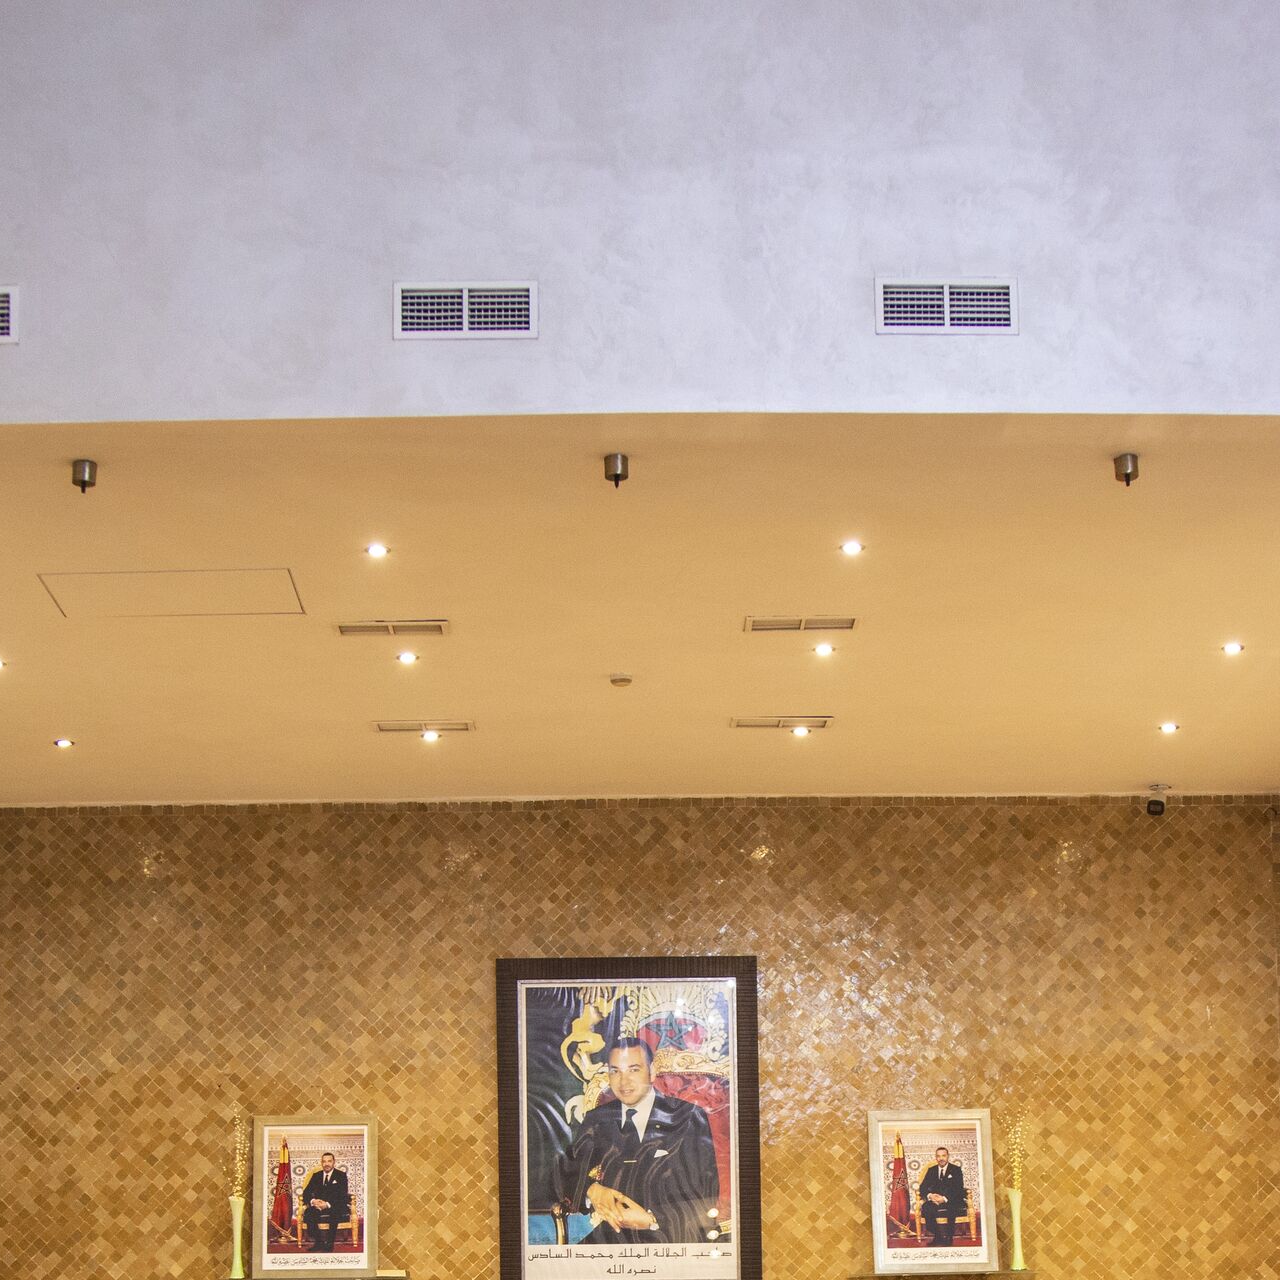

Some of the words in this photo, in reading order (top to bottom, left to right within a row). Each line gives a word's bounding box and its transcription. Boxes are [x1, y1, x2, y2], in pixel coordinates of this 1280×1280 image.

[527, 1248, 572, 1262] السادس
[575, 1252, 614, 1260] محمد
[617, 1248, 650, 1259] الملك
[653, 1247, 687, 1259] الجلالة
[606, 1264, 625, 1274] الله
[627, 1265, 657, 1276] نصره
